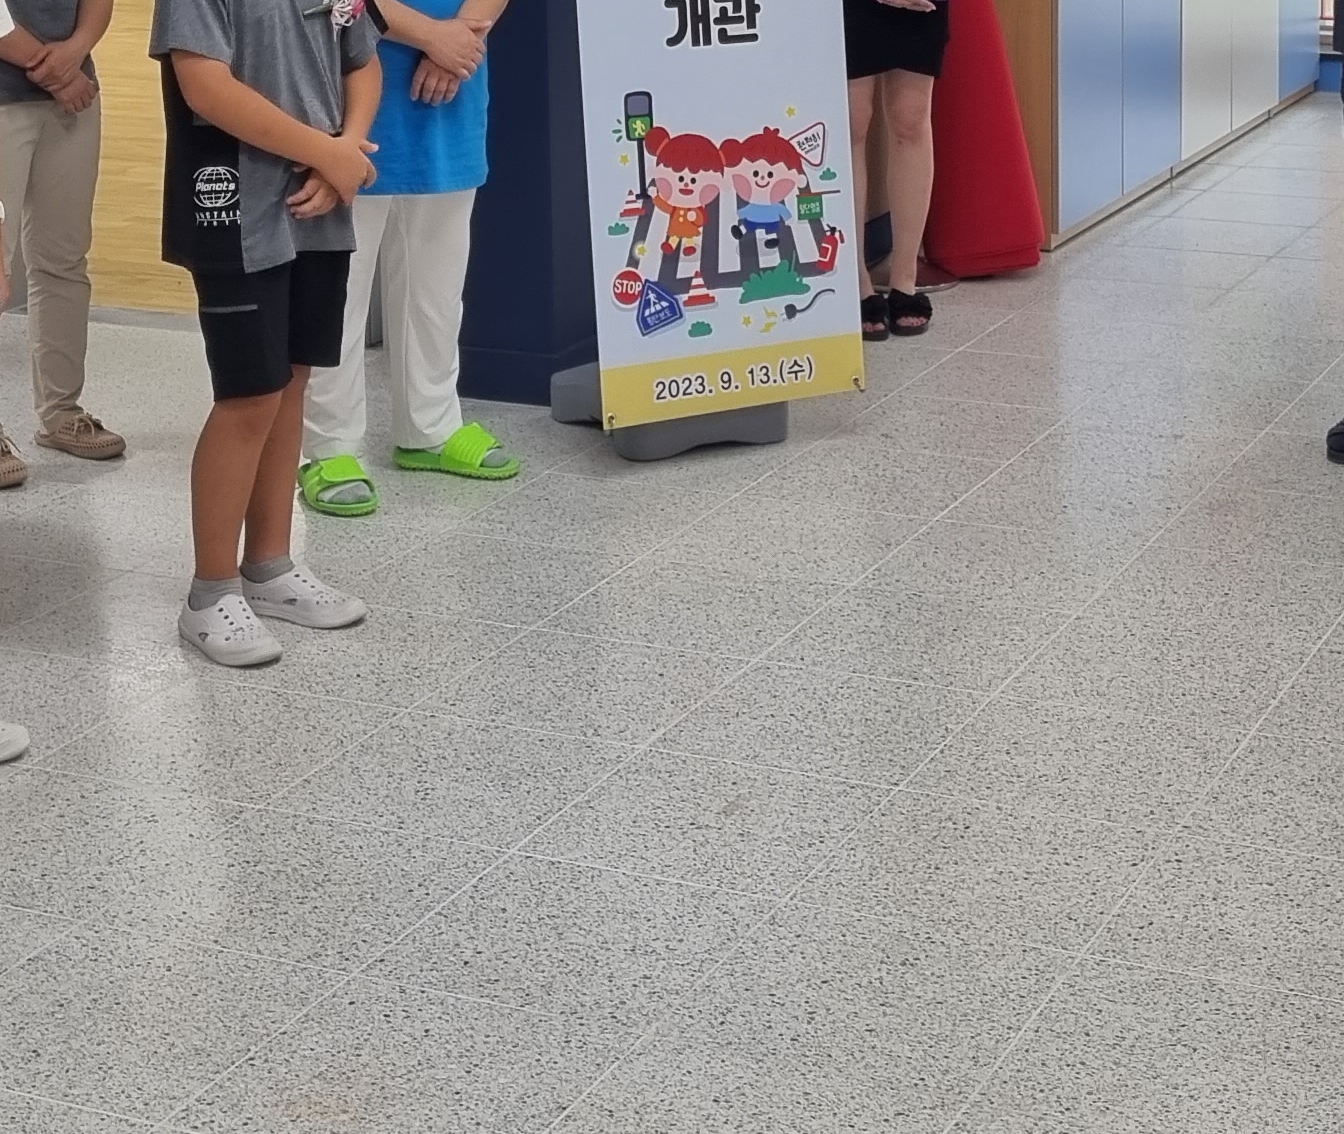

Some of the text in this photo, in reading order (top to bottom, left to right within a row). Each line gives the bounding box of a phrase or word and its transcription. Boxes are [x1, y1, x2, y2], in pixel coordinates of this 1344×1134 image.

[614, 279, 642, 295] STOP
[655, 375, 713, 401] 2023.
[720, 371, 739, 390] 9.
